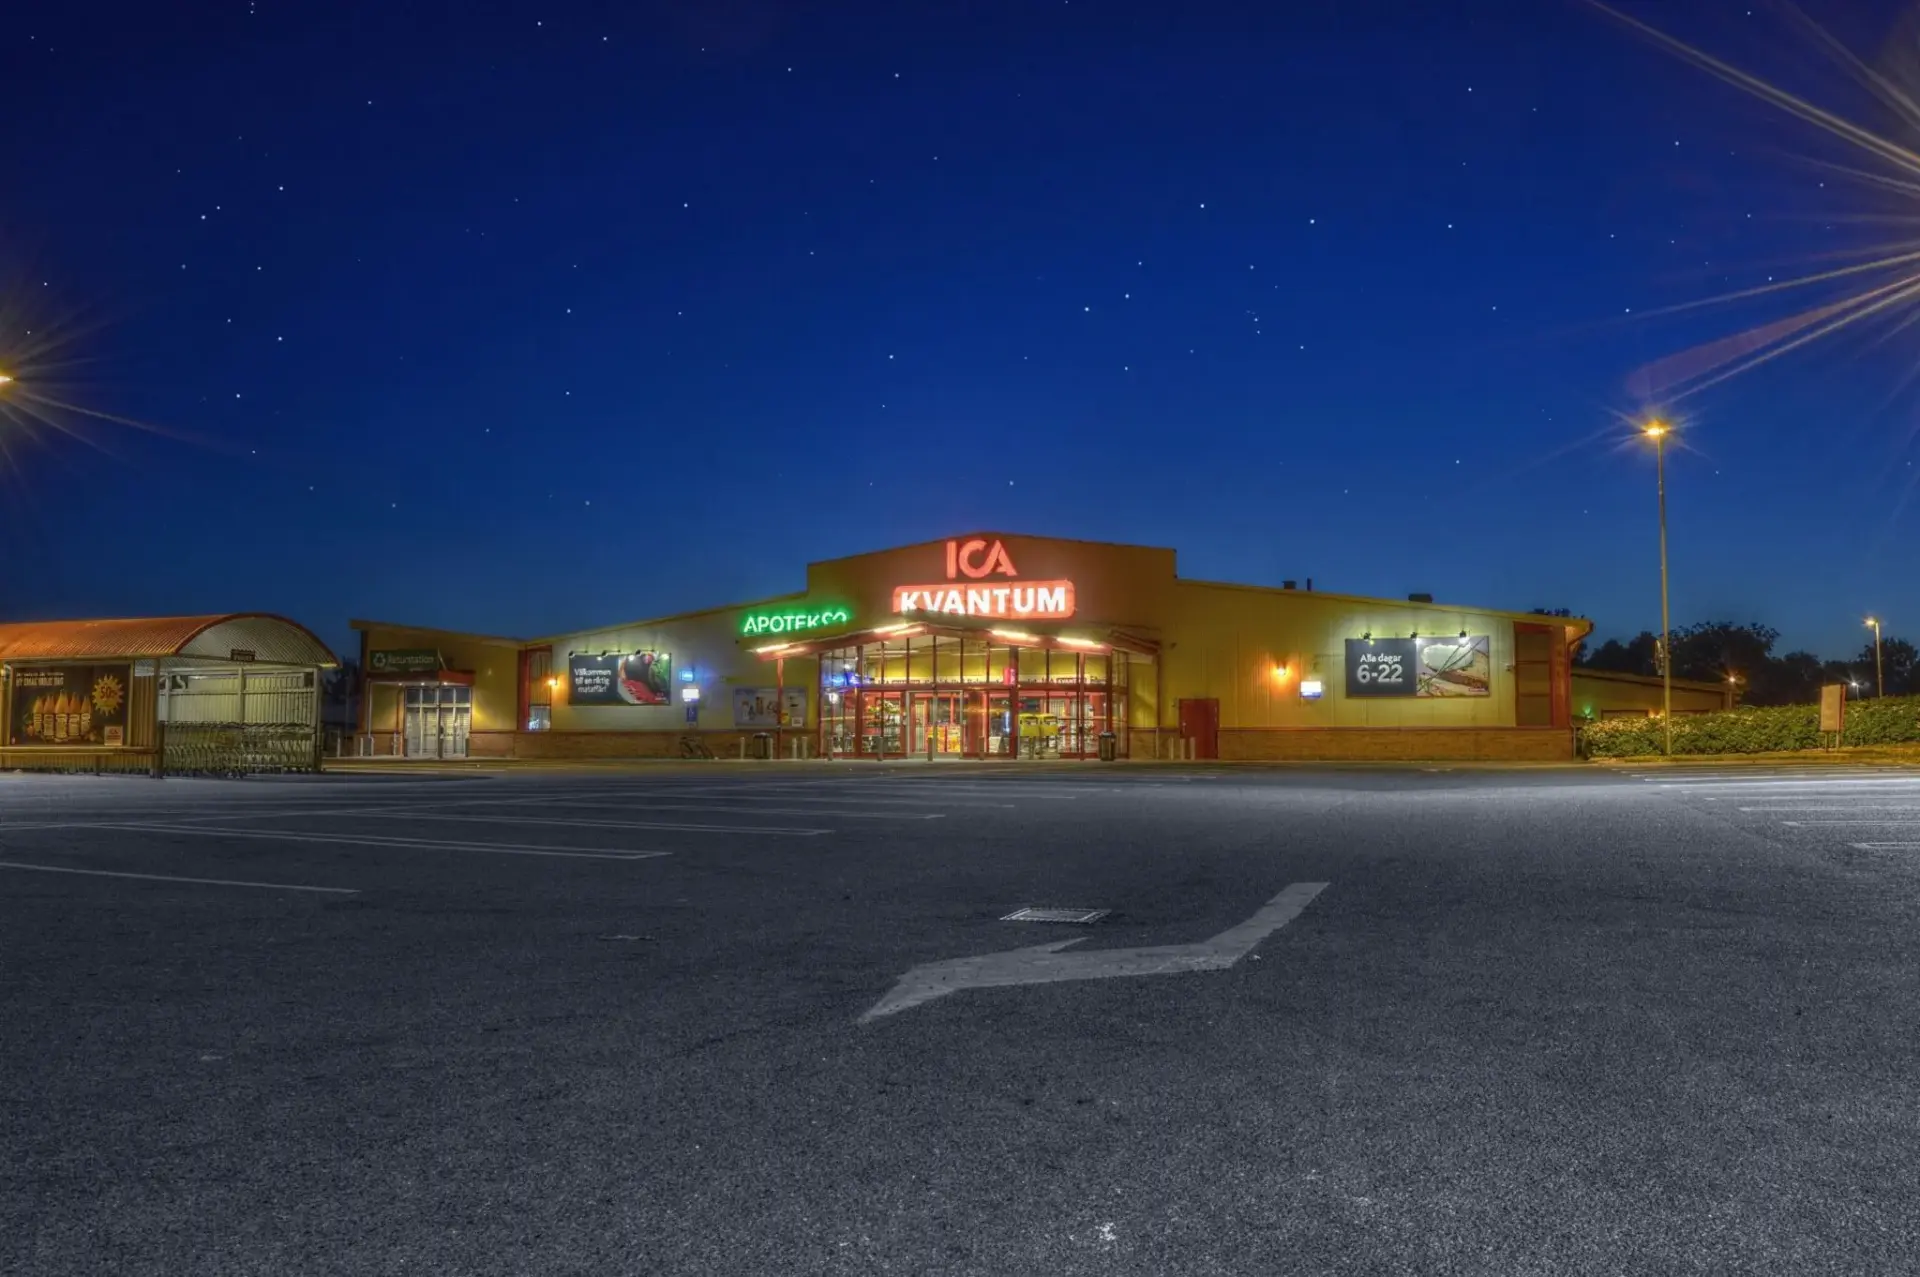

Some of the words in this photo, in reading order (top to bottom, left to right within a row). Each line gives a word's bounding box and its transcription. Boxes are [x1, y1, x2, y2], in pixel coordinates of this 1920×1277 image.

[946, 539, 1018, 579] ICA
[900, 587, 1066, 615] KVANTUM
[743, 614, 820, 633] APOTEK
[1360, 653, 1377, 663] Alla
[1377, 653, 1402, 665] dagar
[574, 668, 612, 676] Välkommen
[575, 676, 584, 685] till
[593, 676, 610, 687] riktig
[1357, 664, 1404, 683] 6-22
